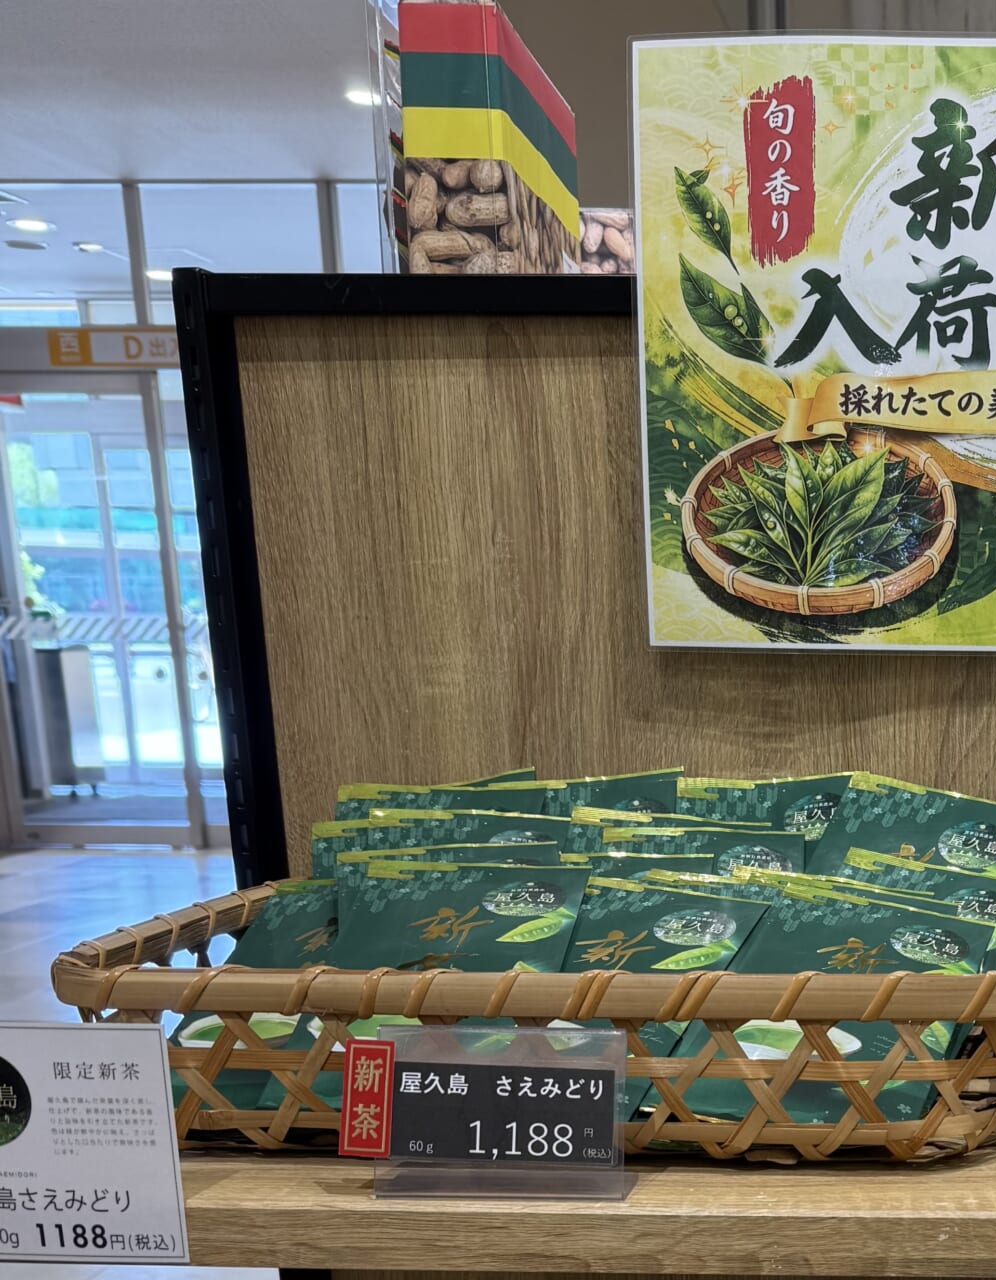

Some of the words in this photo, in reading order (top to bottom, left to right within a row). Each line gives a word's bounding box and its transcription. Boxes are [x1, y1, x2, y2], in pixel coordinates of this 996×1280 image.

[763, 97, 801, 244] 旬の香り
[123, 335, 144, 359] D
[52, 1061, 141, 1081] 限定新茶
[351, 1056, 383, 1141] 新茶
[400, 1072, 469, 1096] 屋久島
[496, 1075, 605, 1101] さえみどり
[468, 1120, 574, 1160] 1,188
[583, 1127, 595, 1139] 円
[582, 1147, 612, 1160] (税込)
